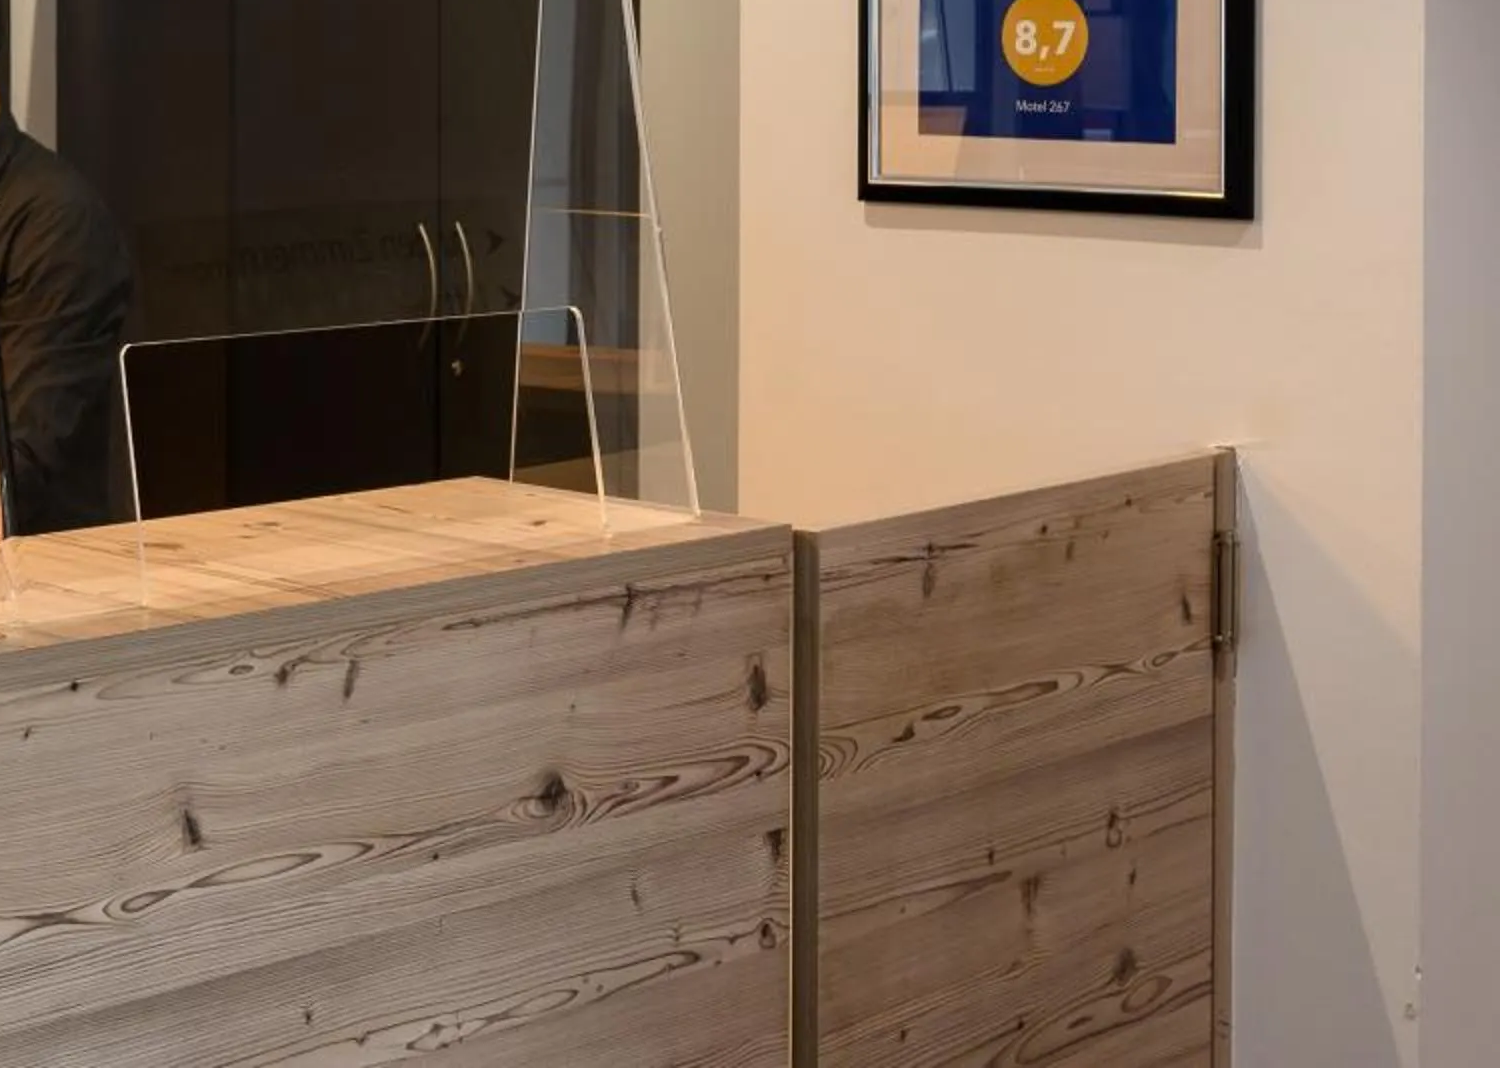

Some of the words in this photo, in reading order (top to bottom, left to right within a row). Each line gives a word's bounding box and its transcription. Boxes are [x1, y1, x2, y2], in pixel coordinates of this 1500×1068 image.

[1015, 19, 1076, 61] 8,7
[1016, 99, 1047, 113] Motel
[1049, 100, 1071, 114] 267
